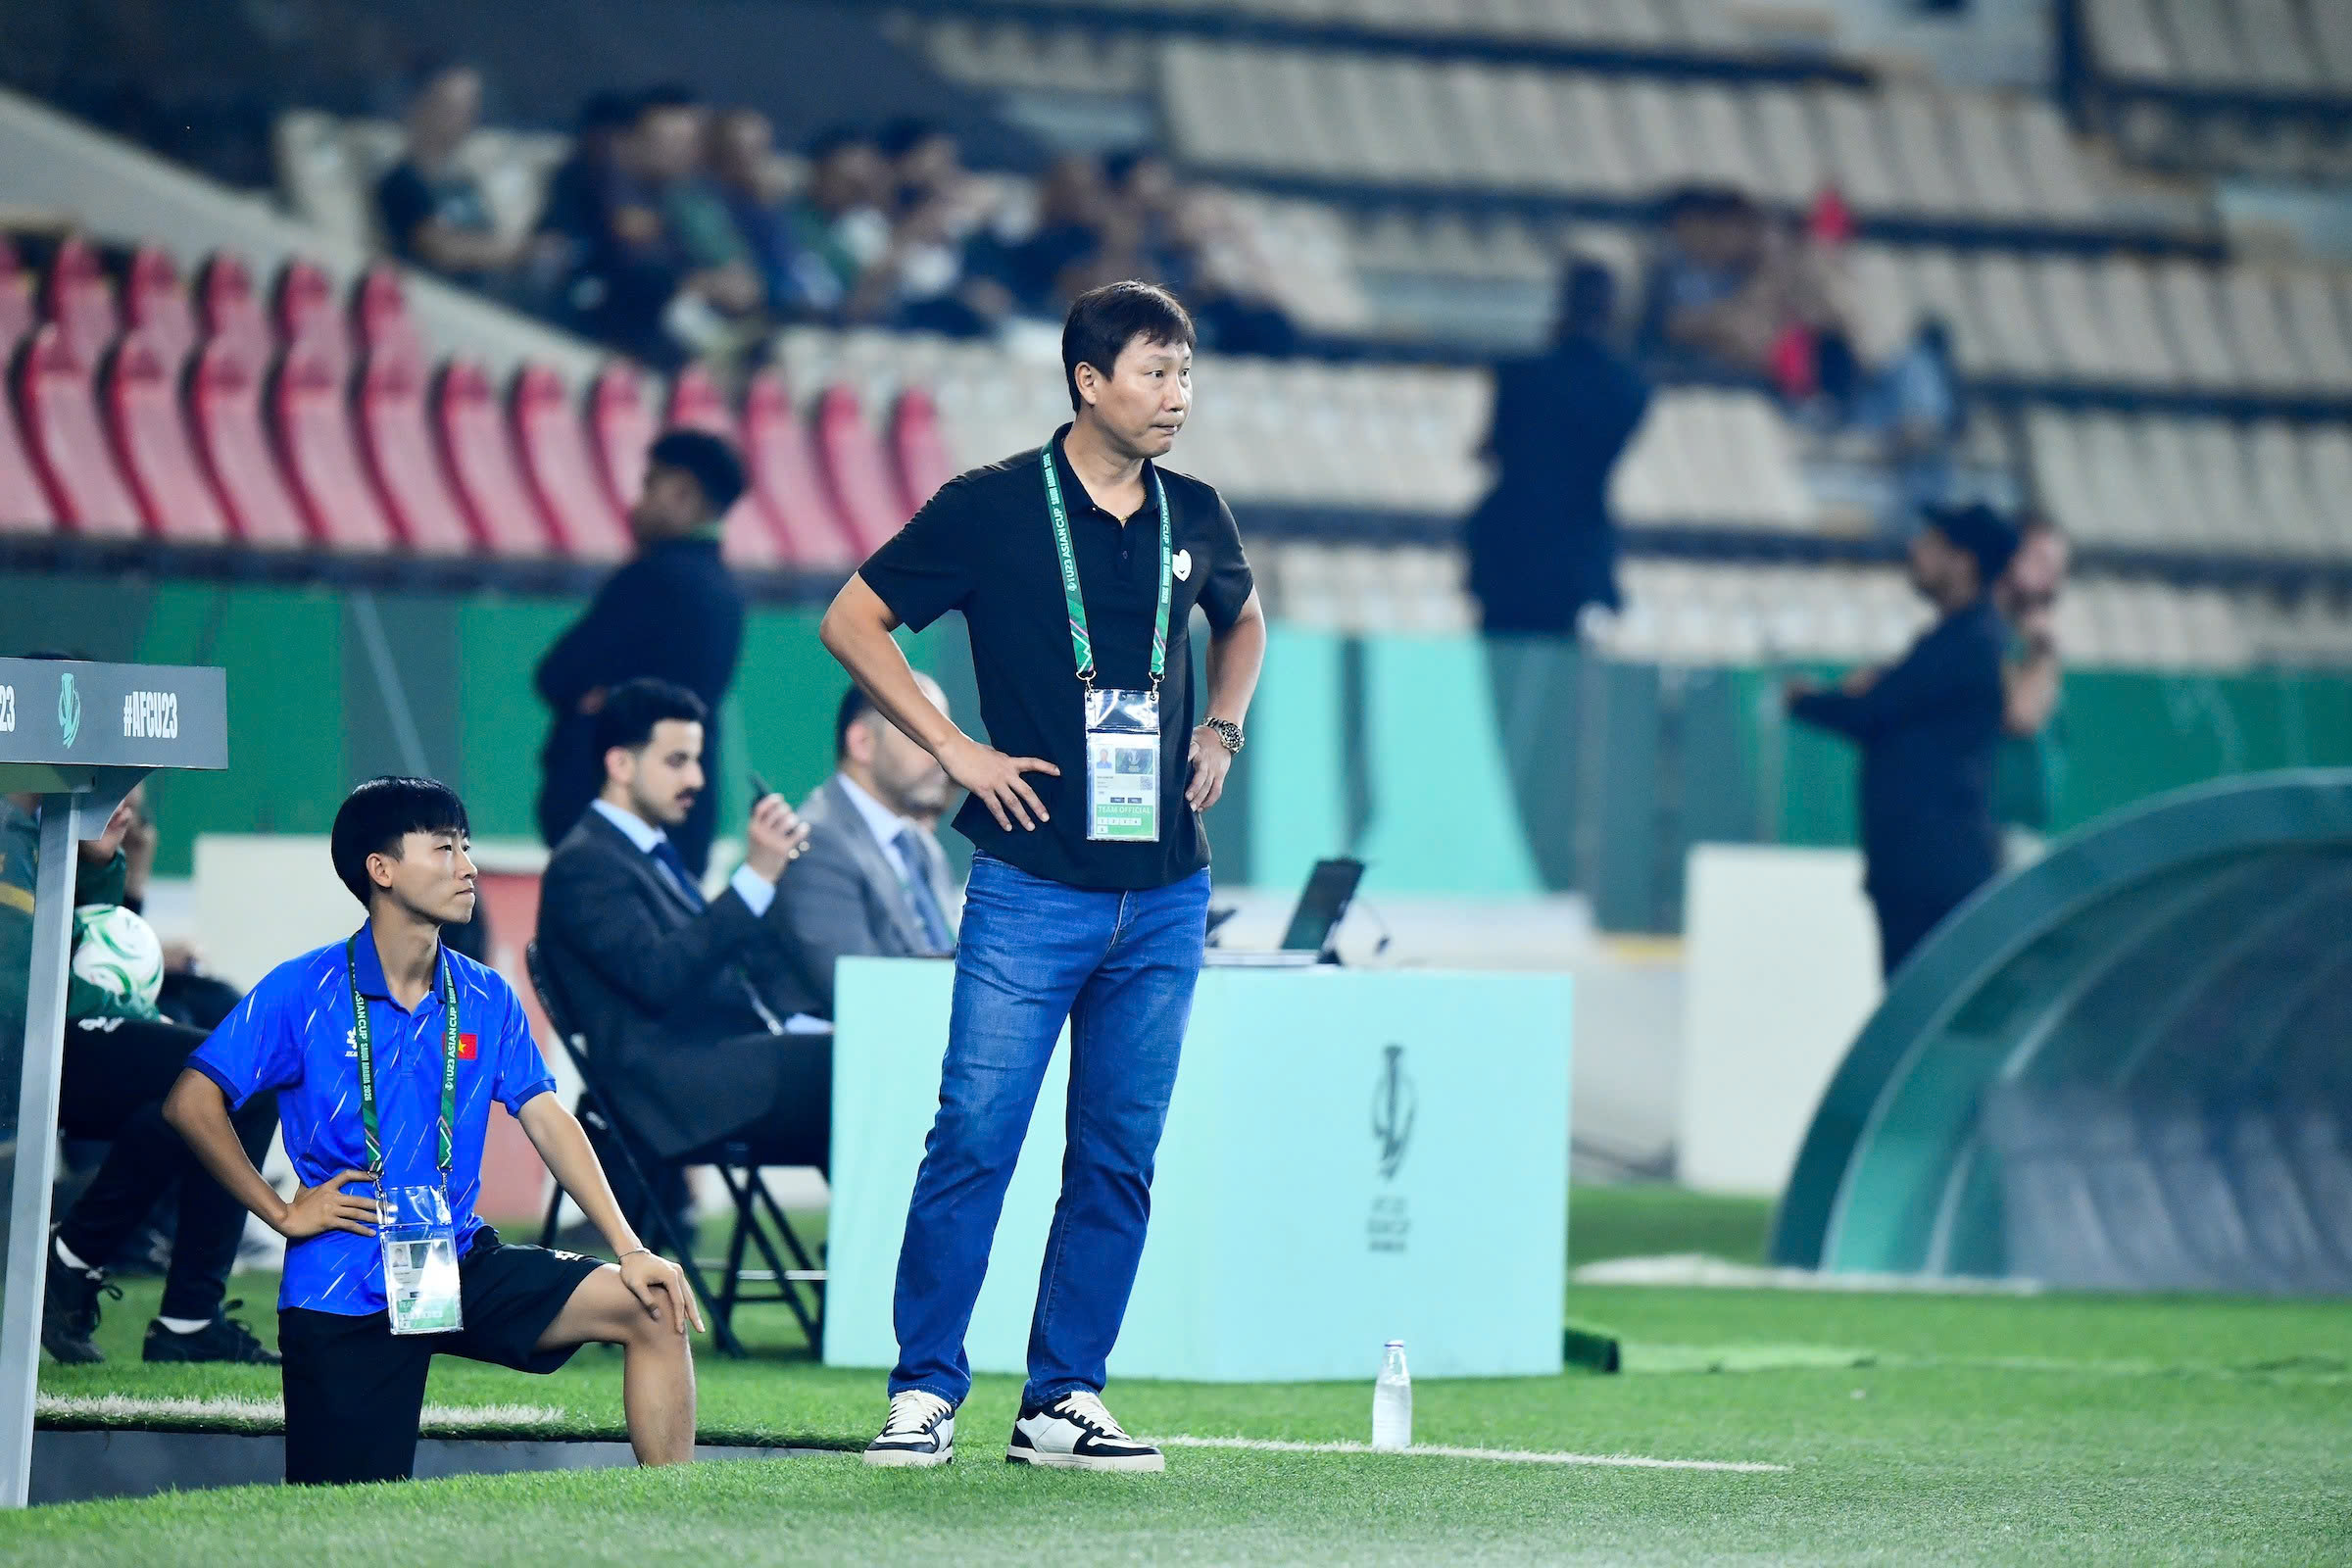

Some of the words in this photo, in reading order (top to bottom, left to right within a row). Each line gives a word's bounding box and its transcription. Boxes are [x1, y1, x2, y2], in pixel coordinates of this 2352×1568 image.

[1054, 508, 1064, 528] CUP
[1057, 528, 1071, 558] ASIAN
[1064, 559, 1075, 578] U23
[123, 691, 178, 739] #AFCU23
[358, 1019, 368, 1040] CUP
[361, 1043, 369, 1061] SAUDI
[448, 1027, 457, 1057] ASIAN
[362, 1061, 370, 1084] ARABIA
[364, 1084, 372, 1102] 2026
